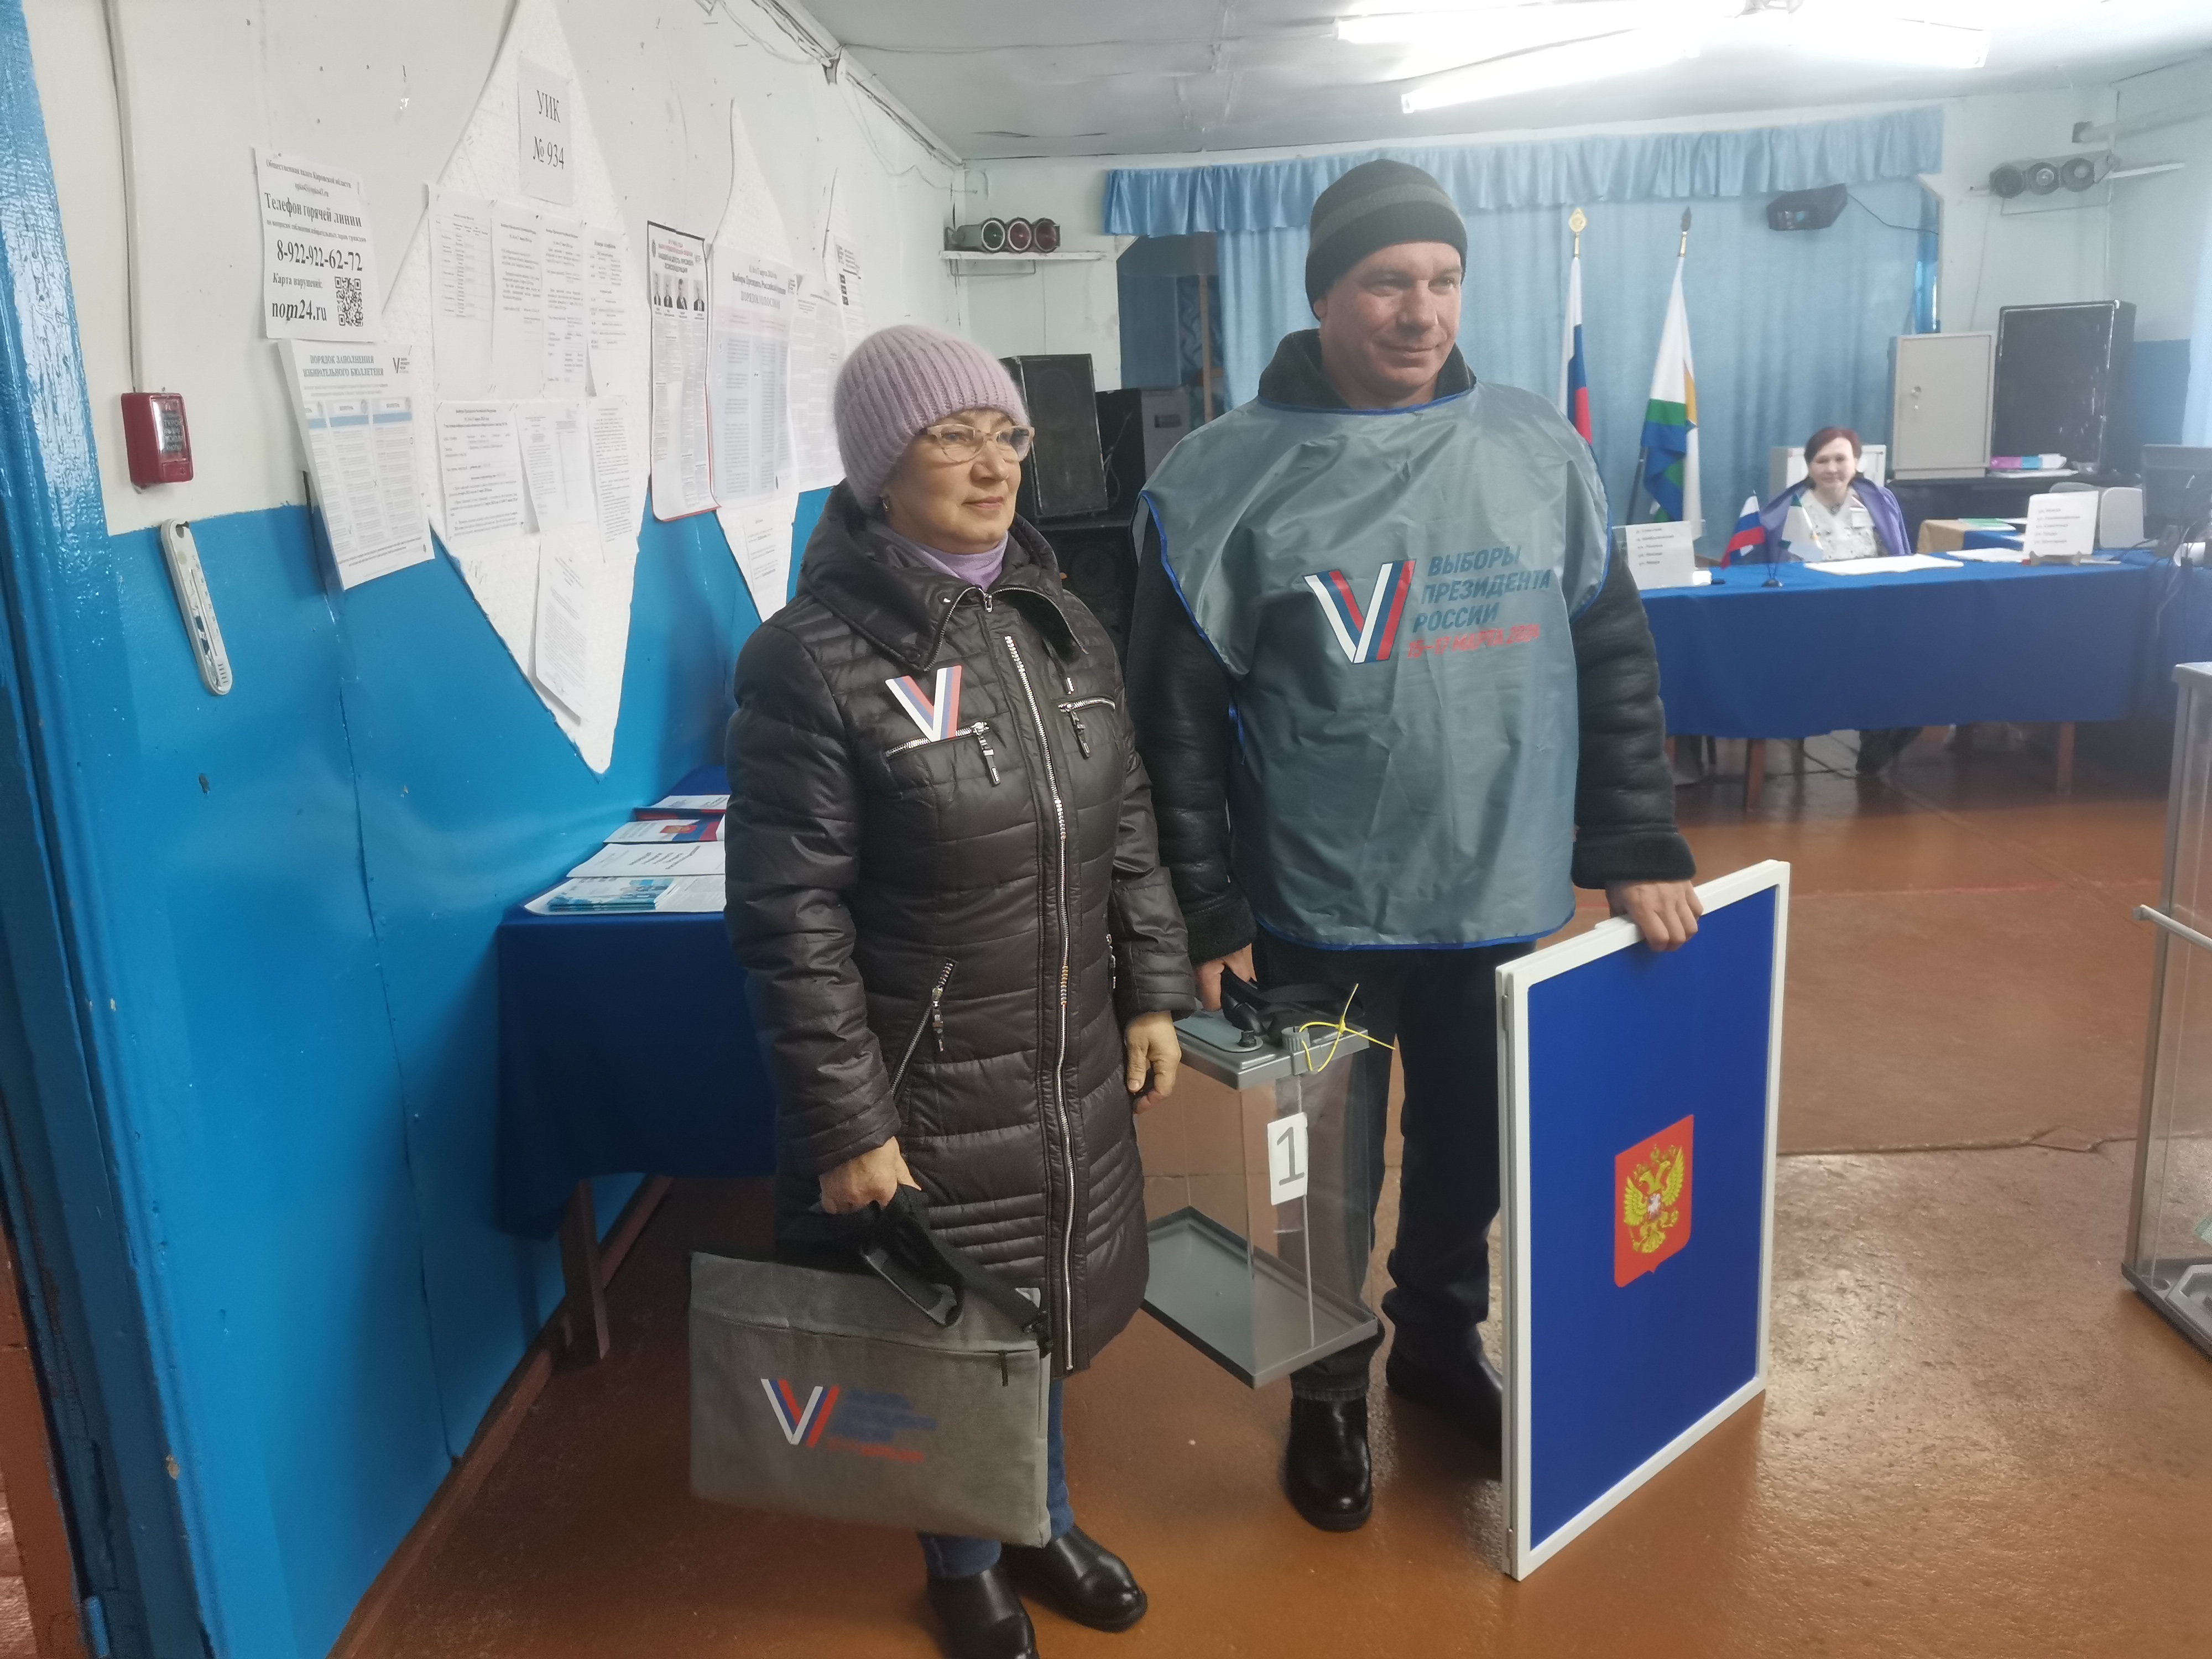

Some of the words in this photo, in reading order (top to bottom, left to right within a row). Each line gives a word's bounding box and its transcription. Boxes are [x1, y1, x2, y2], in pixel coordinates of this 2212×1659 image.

[536, 90, 560, 123] УИК
[533, 136, 544, 163] №
[547, 142, 564, 170] 934
[264, 192, 302, 217] Телефон
[303, 205, 332, 222] горячей
[333, 212, 362, 227] линии
[277, 239, 363, 271] 8-922-922-62-72
[273, 272, 292, 287] Карта
[272, 299, 327, 321] nom24.ru
[302, 368, 350, 378] ИЗБИРАТЕЛЬНОГО
[350, 367, 384, 377] БЮЛЛЕТЕНЯ
[309, 354, 336, 364] ПОРЯДОК
[336, 354, 374, 364] ЗАПОЛНЕНИЯ
[1428, 545, 1521, 577] ВЫБОРЫ
[1421, 569, 1551, 604] ПРЕЗИДЕНТА
[1412, 602, 1500, 633] РОССИИ
[1452, 628, 1503, 651] МАРТА
[1277, 1126, 1305, 1186] 1
